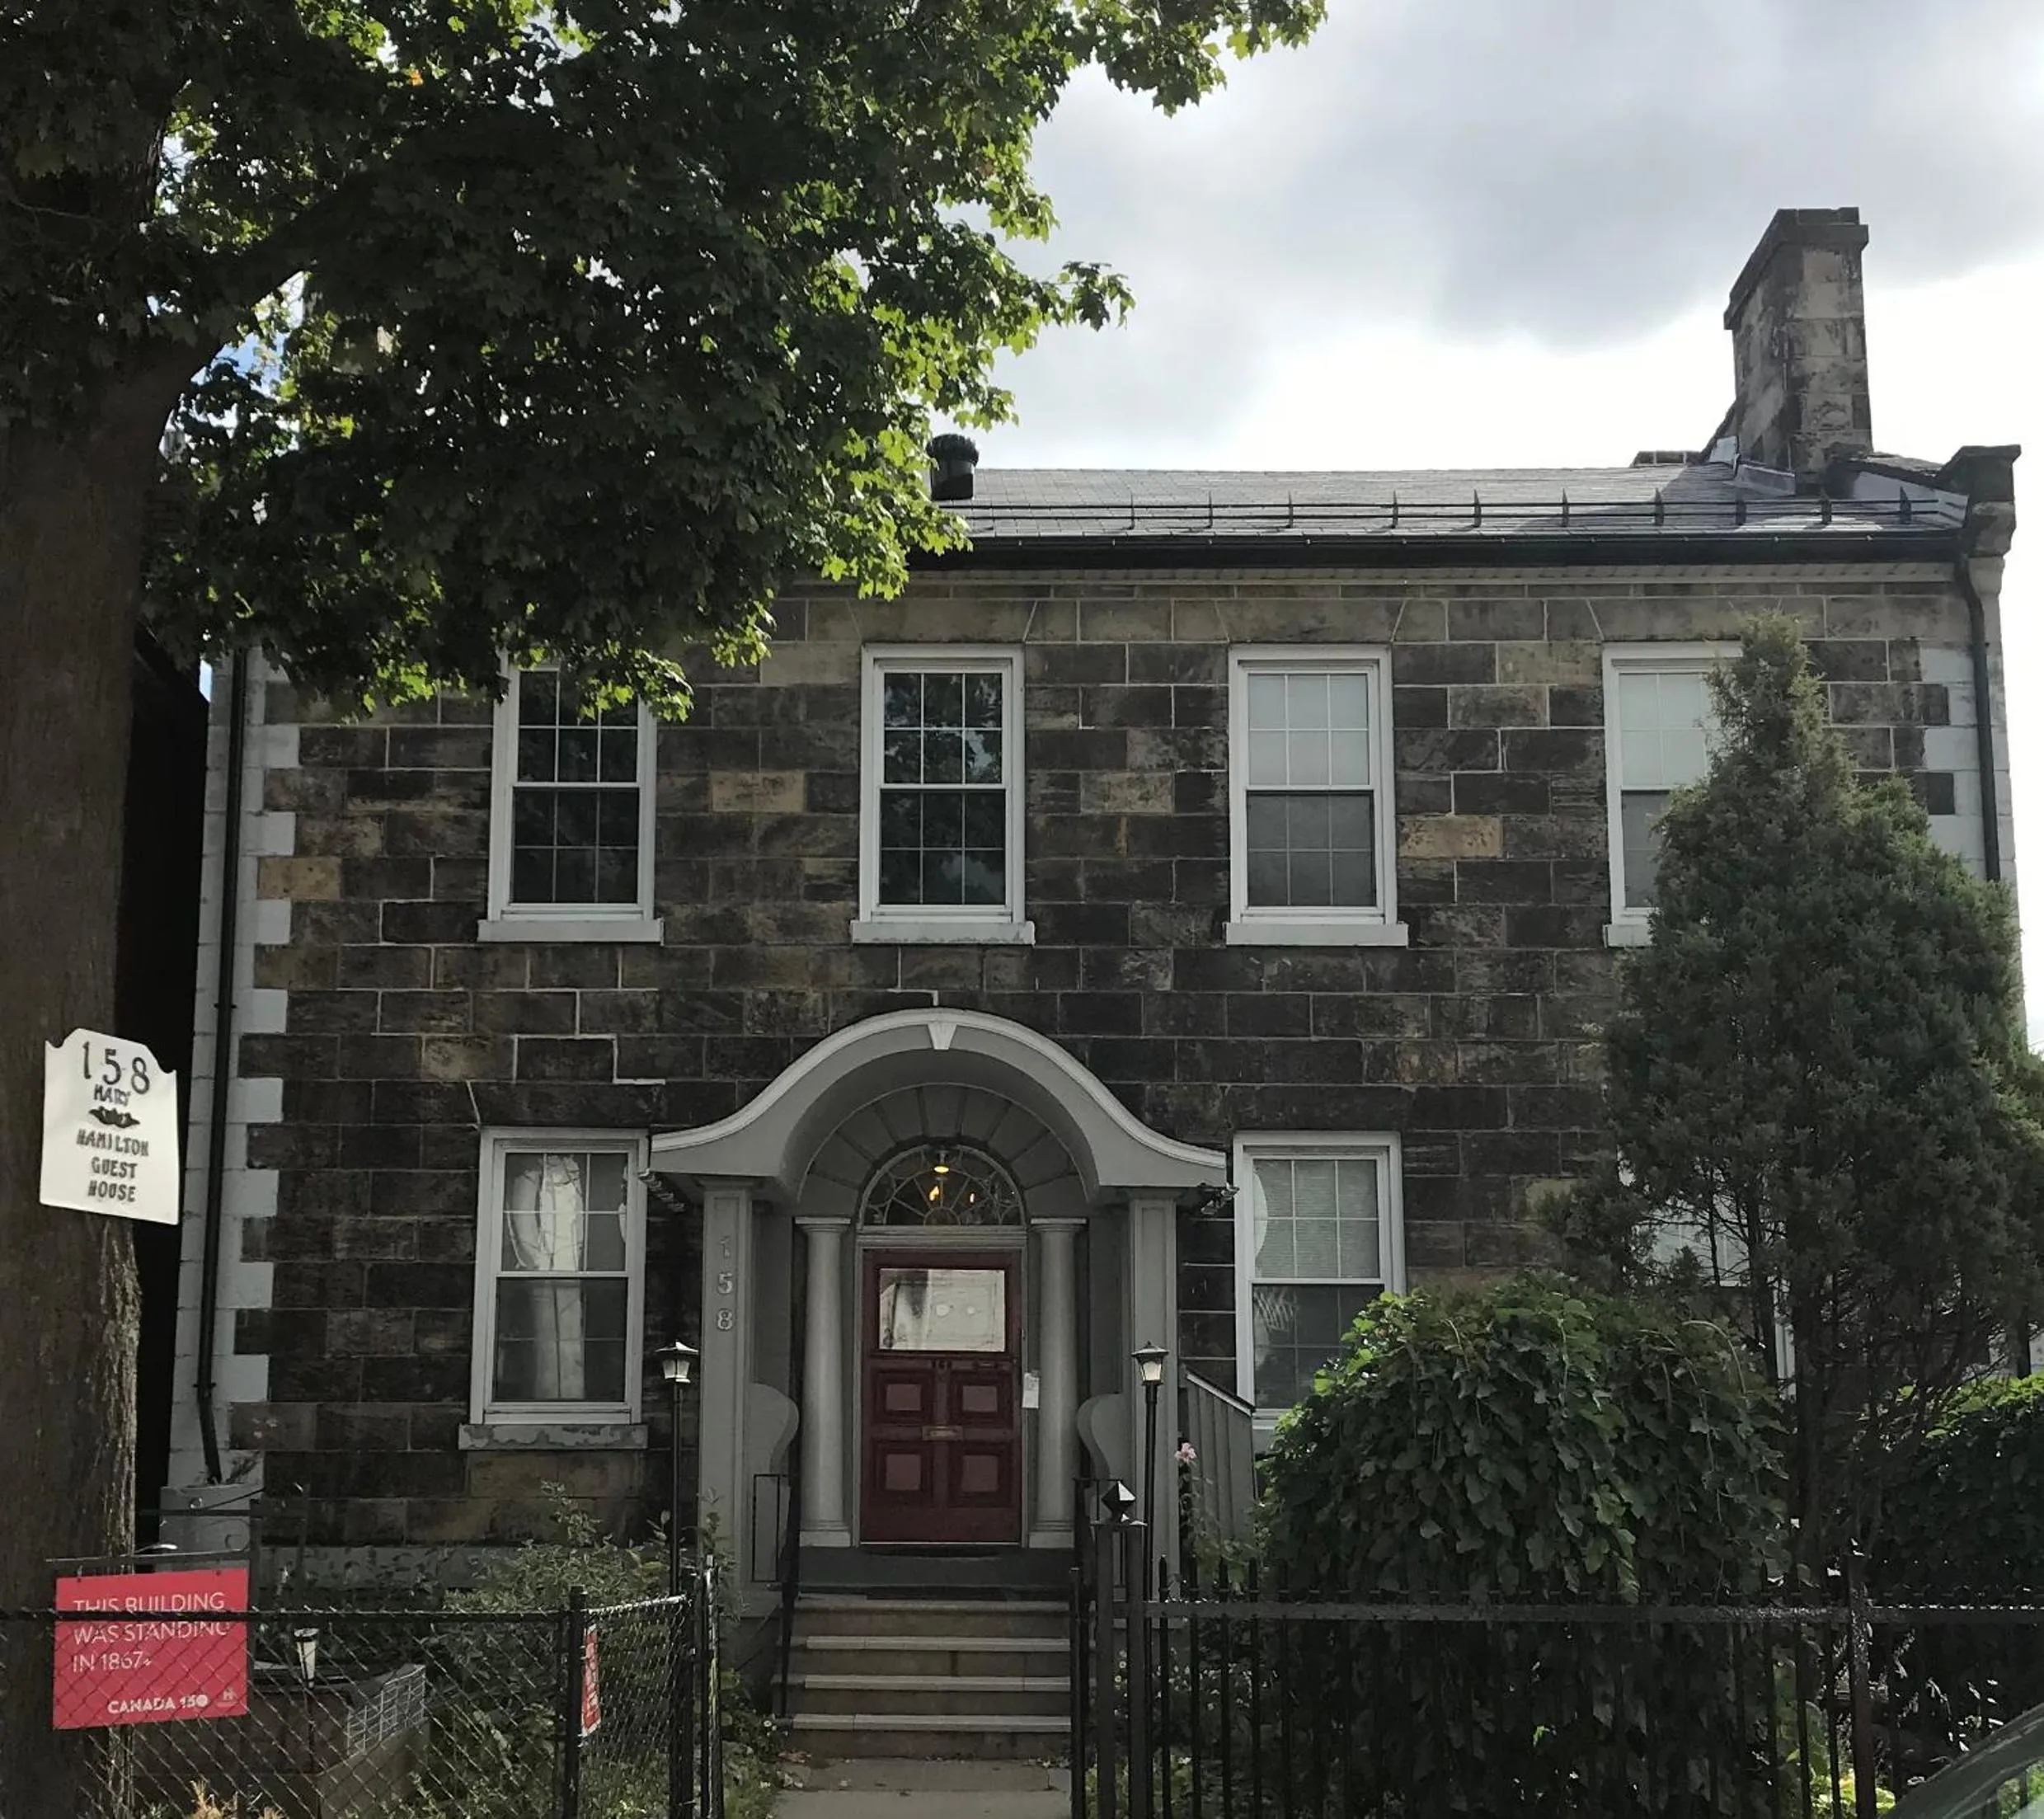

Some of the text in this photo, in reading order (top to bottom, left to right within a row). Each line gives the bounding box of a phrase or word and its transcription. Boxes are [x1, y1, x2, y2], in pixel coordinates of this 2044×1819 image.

[82, 1041, 150, 1095] 158
[77, 1129, 148, 1157] HAMILTON
[92, 1157, 137, 1178] GUEST
[88, 1181, 136, 1202] HOUSE
[125, 1592, 225, 1611] BUILDING
[73, 1624, 119, 1645] WAS
[73, 1654, 95, 1672] IN
[107, 1697, 176, 1714] CANADA
